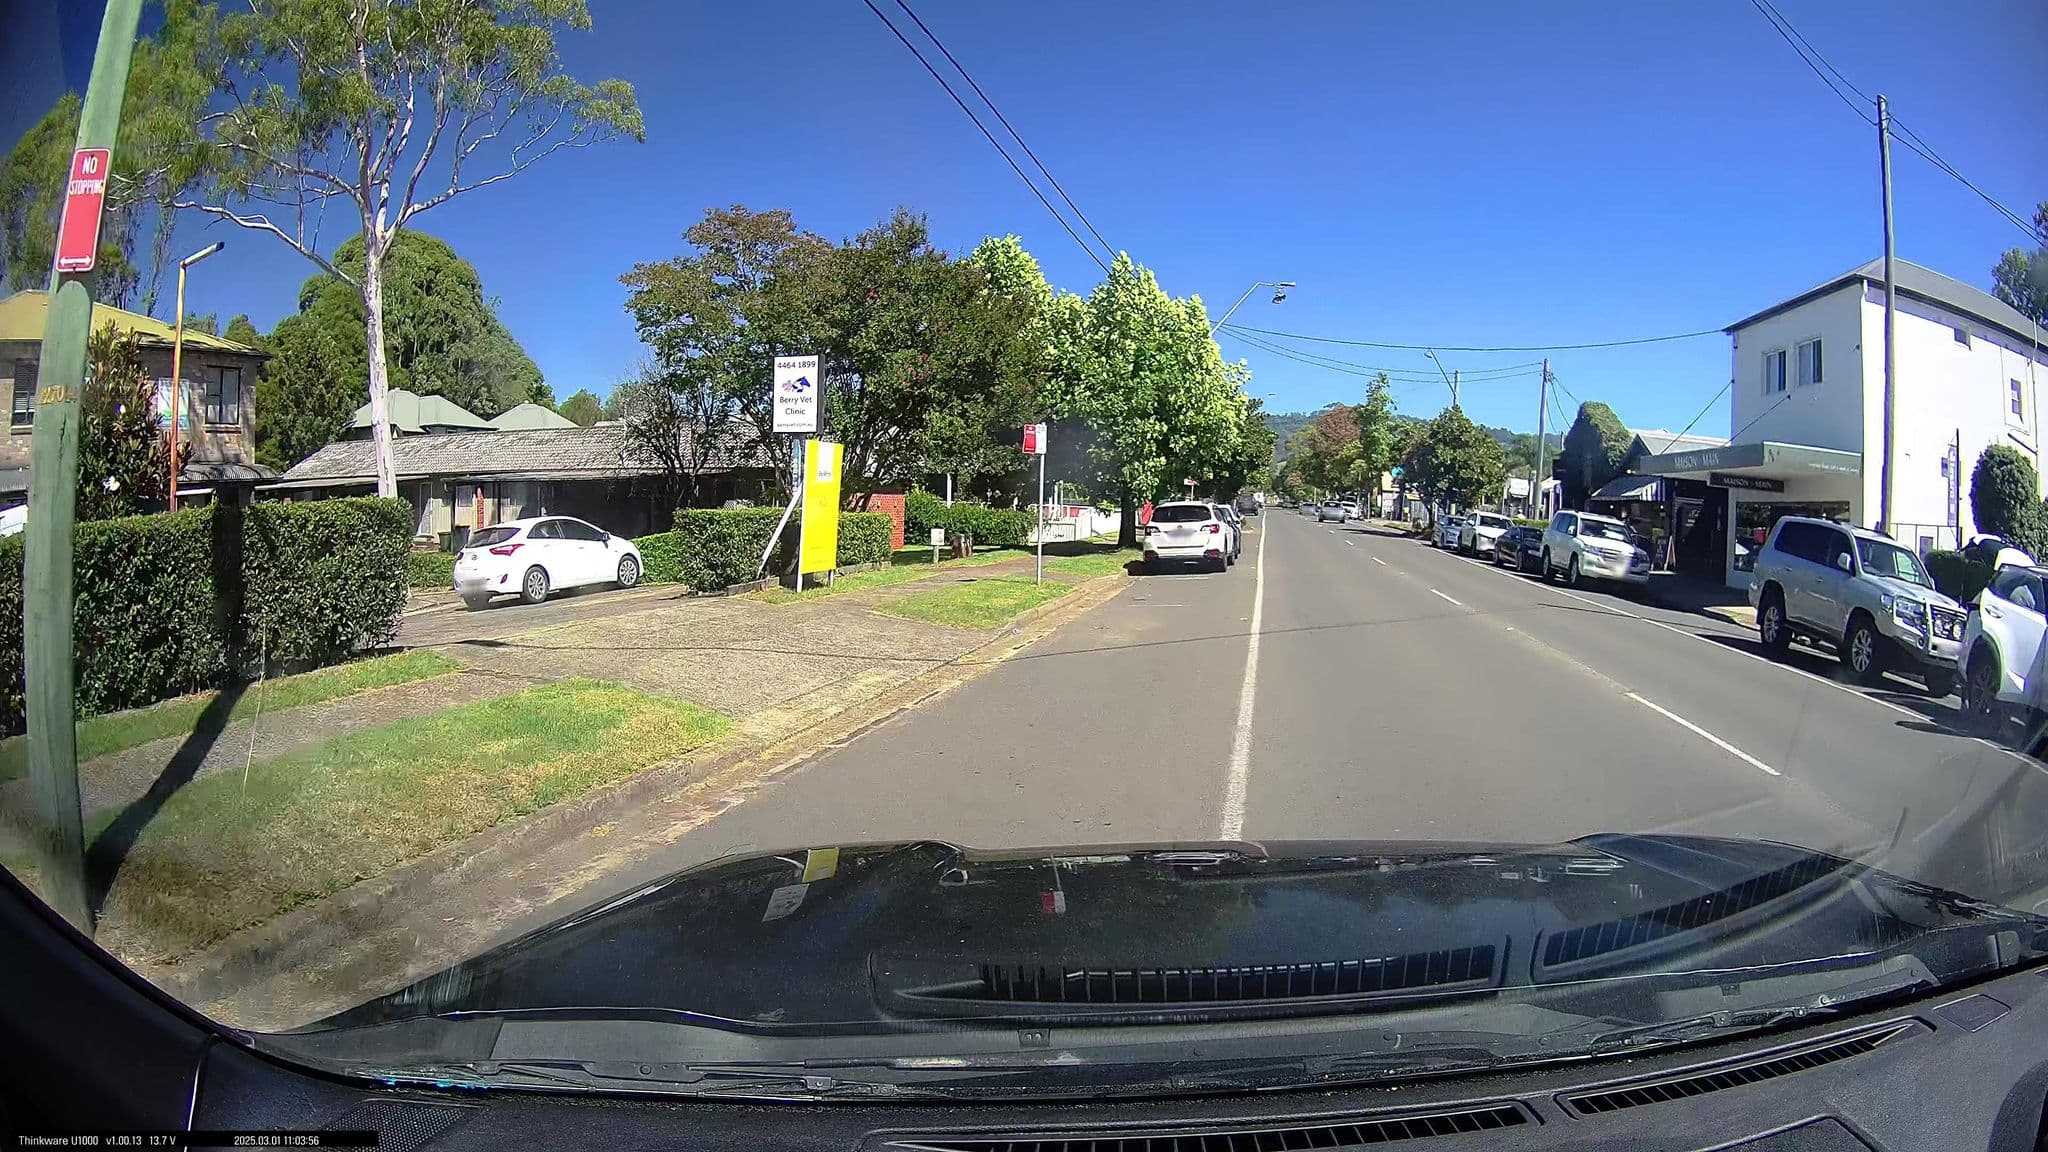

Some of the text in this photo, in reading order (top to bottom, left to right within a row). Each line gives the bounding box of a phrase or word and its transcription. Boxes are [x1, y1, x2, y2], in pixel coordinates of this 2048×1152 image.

[82, 156, 98, 174] NO
[69, 179, 105, 196] STOPPING
[798, 361, 816, 369] 1899
[779, 396, 799, 405] Berry
[785, 407, 806, 415] Clinic
[1674, 452, 1719, 469] MAISON MAIN
[1723, 477, 1749, 486] MAISON
